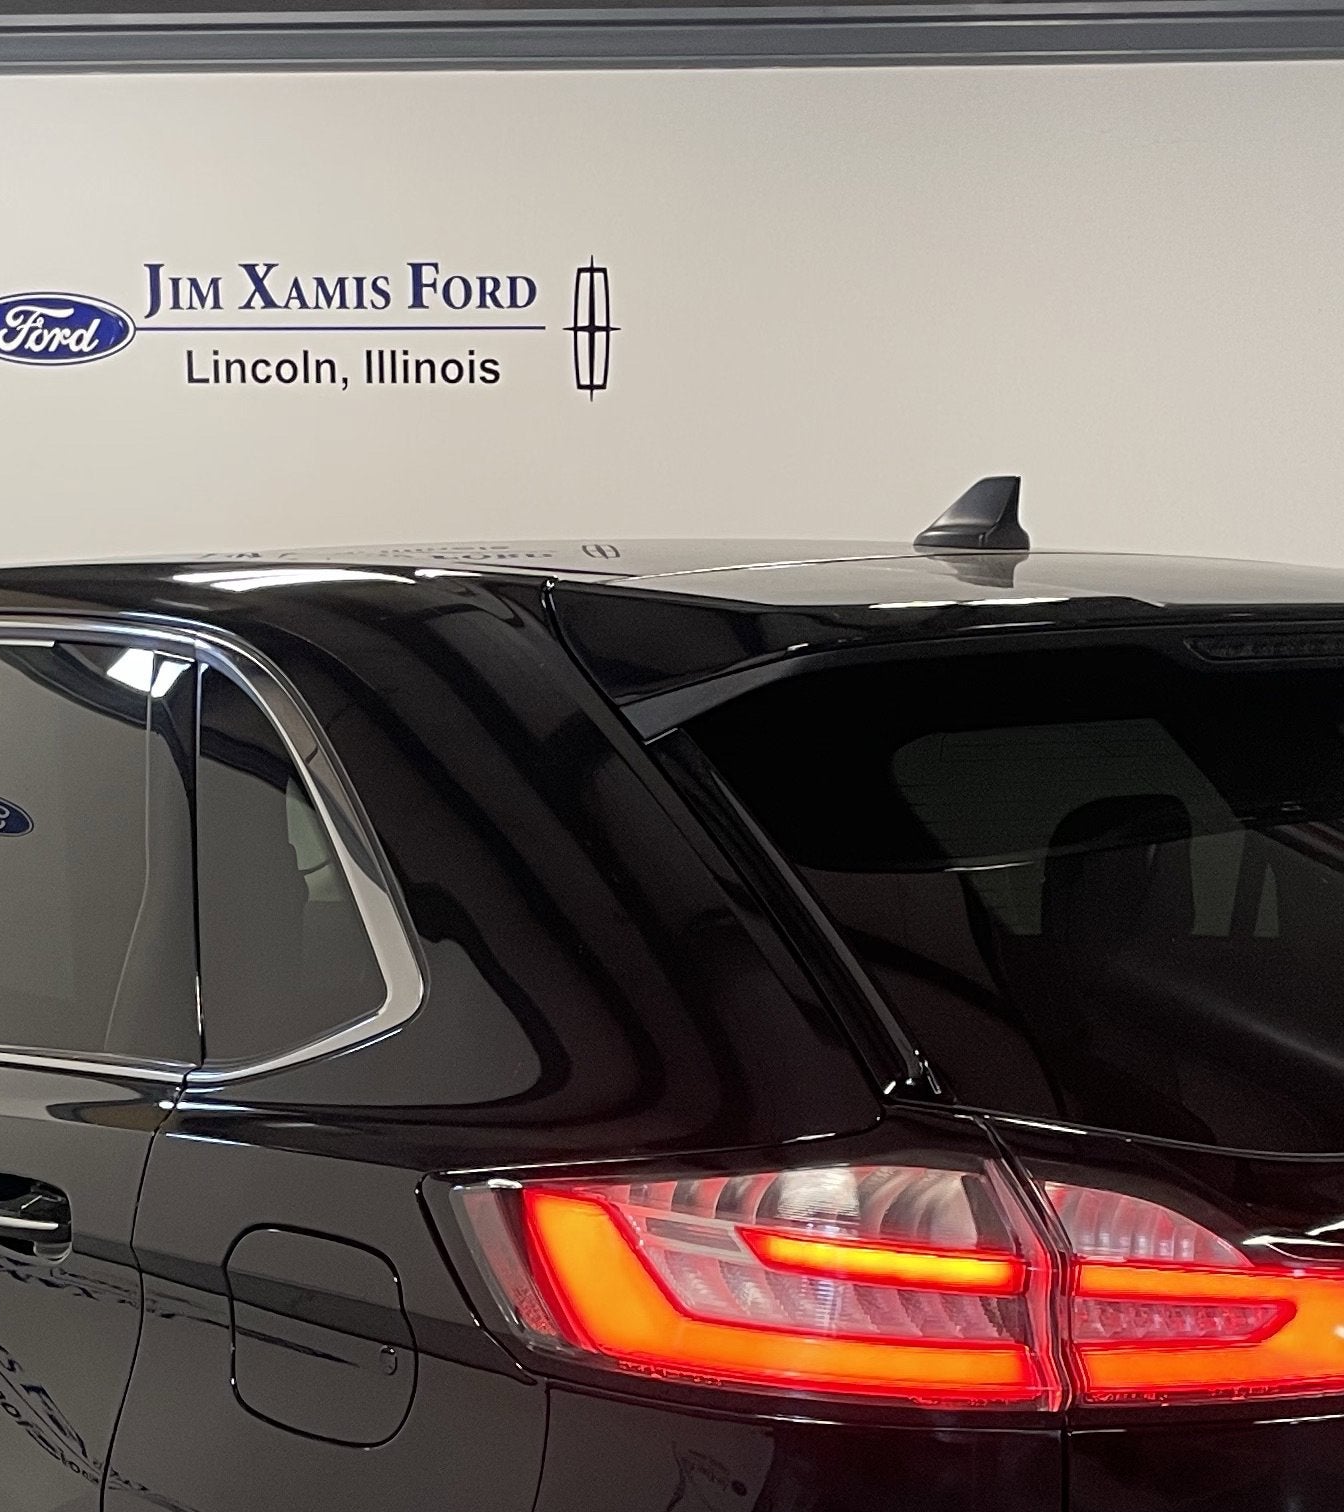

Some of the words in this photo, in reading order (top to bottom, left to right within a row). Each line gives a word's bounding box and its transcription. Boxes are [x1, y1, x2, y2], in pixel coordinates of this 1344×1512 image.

[237, 261, 392, 311] XAMIS
[406, 261, 539, 311] FORD
[186, 349, 349, 391] Lincoln,
[365, 349, 502, 385] Illinois
